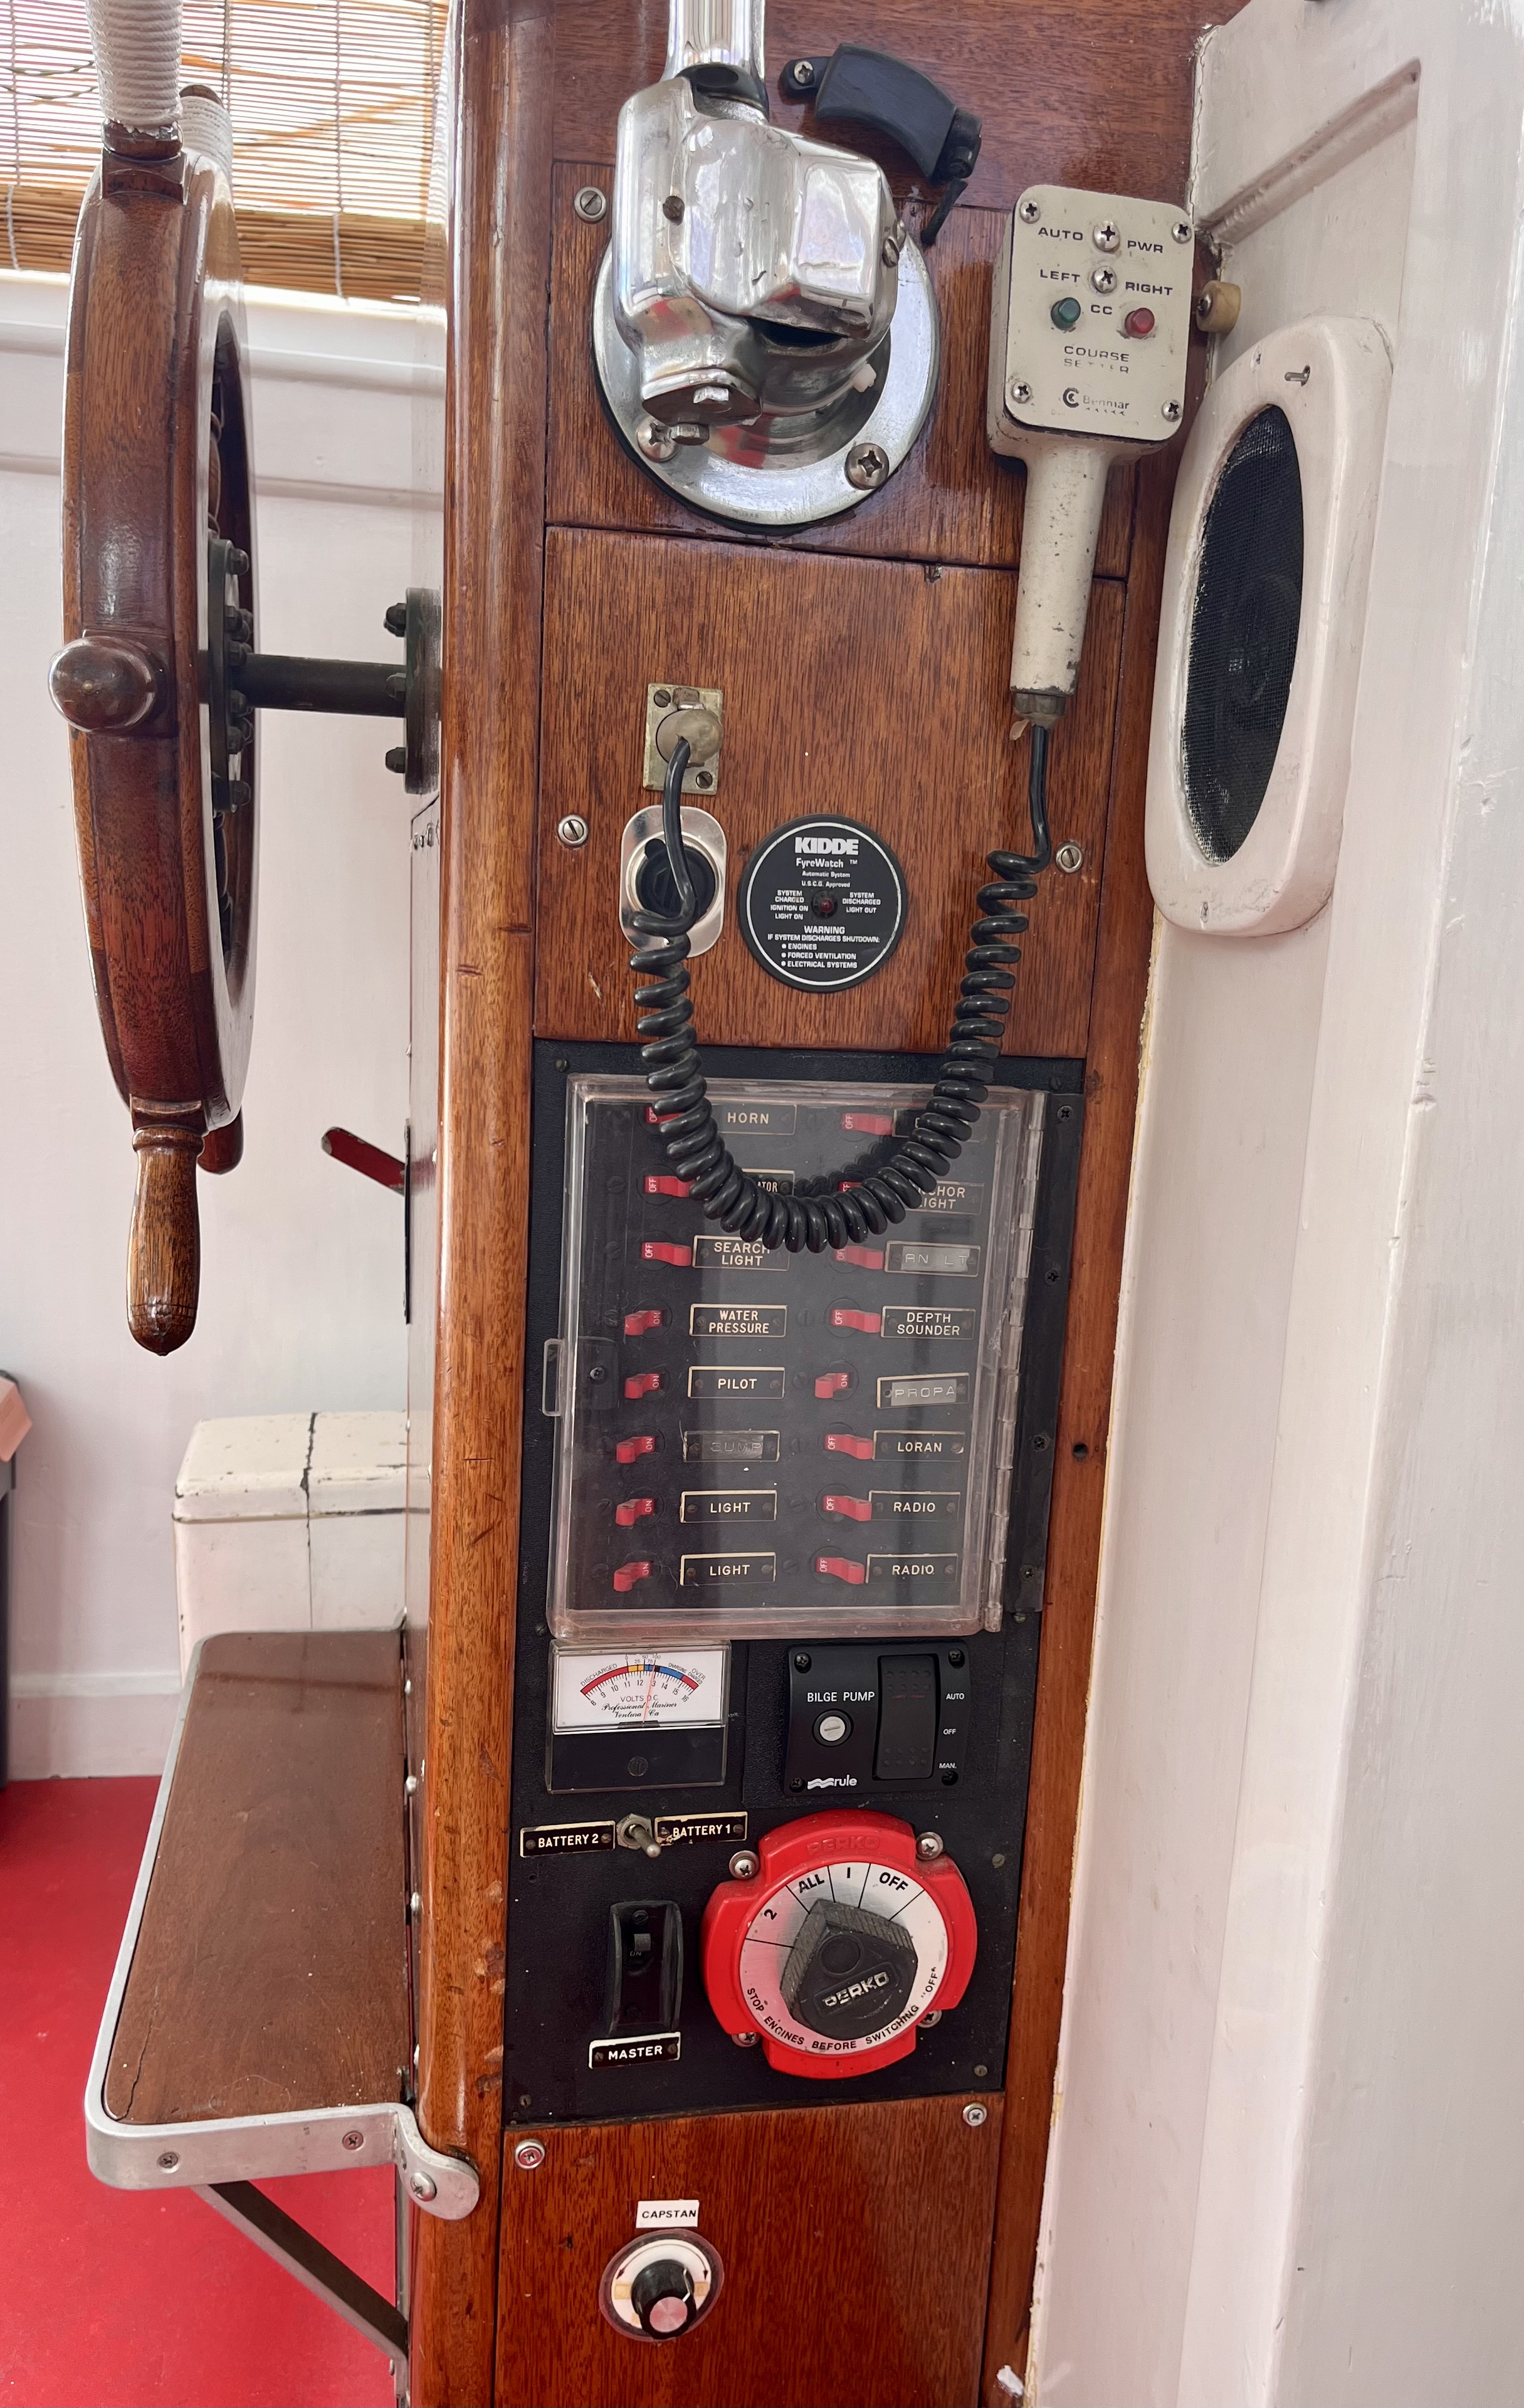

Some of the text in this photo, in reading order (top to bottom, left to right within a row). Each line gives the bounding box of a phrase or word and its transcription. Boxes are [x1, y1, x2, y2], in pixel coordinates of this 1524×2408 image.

[1038, 227, 1083, 241] AUTO
[1127, 240, 1164, 253] PWR
[1039, 269, 1081, 283] LEFT
[1125, 281, 1174, 296] RIGHT
[1090, 304, 1113, 315] CC
[1064, 345, 1130, 362] COURSE
[795, 837, 859, 855] KIDDE
[796, 858, 844, 869] FyreWatch
[831, 871, 850, 879] System
[804, 925, 846, 935] WARNING
[727, 1112, 770, 1124] HORN
[844, 1115, 853, 1129] OFF
[648, 1177, 657, 1192] OFF
[920, 1197, 956, 1209] IGHT
[644, 1243, 653, 1258] OFF
[713, 1242, 770, 1254] SEARCH
[722, 1255, 764, 1266] LIGHT
[653, 1312, 661, 1325] ON
[719, 1310, 759, 1321] WATER
[834, 1310, 843, 1325] OFF
[907, 1312, 952, 1323] DEPTH
[708, 1323, 770, 1334] PRESSURE
[896, 1324, 960, 1336] SOUNDER
[652, 1375, 660, 1389] ON
[718, 1378, 757, 1390] PILOT
[841, 1374, 848, 1387] ON
[895, 1386, 955, 1399] PROPA
[646, 1438, 654, 1451] ON
[828, 1436, 836, 1450] OFF
[896, 1441, 942, 1453] LORAN
[644, 1500, 653, 1513] ON
[710, 1502, 752, 1514] LIGHT
[826, 1497, 835, 1511] OFF
[893, 1501, 936, 1513] RADIO
[642, 1563, 649, 1577] ON
[710, 1564, 751, 1577] LIGHT
[819, 1559, 828, 1572] OFF
[891, 1565, 935, 1576] RADIO
[580, 1663, 618, 1687] DISCHARGED
[691, 1668, 706, 1681] OVER
[611, 1685, 619, 1693] 10
[661, 1682, 668, 1690] 14
[672, 1687, 680, 1695] 15
[681, 1695, 690, 1703] 16
[807, 1691, 875, 1702] BILGE PUMP
[601, 1702, 646, 1713] Professional
[672, 1824, 731, 1839] BATTERY 1
[538, 1834, 599, 1849] BATTERY 2
[798, 1873, 825, 1894] ALL
[878, 1871, 909, 1892] OFF
[764, 1908, 777, 1921] 2
[821, 1971, 890, 2008] PERKO
[747, 1987, 765, 2012] STOP
[763, 2014, 806, 2046] ENGINES
[811, 2039, 857, 2051] BEFORE
[864, 2004, 920, 2045] SWITCHING
[607, 2044, 663, 2061] MASTER
[641, 2209, 697, 2219] CAPSTAN
